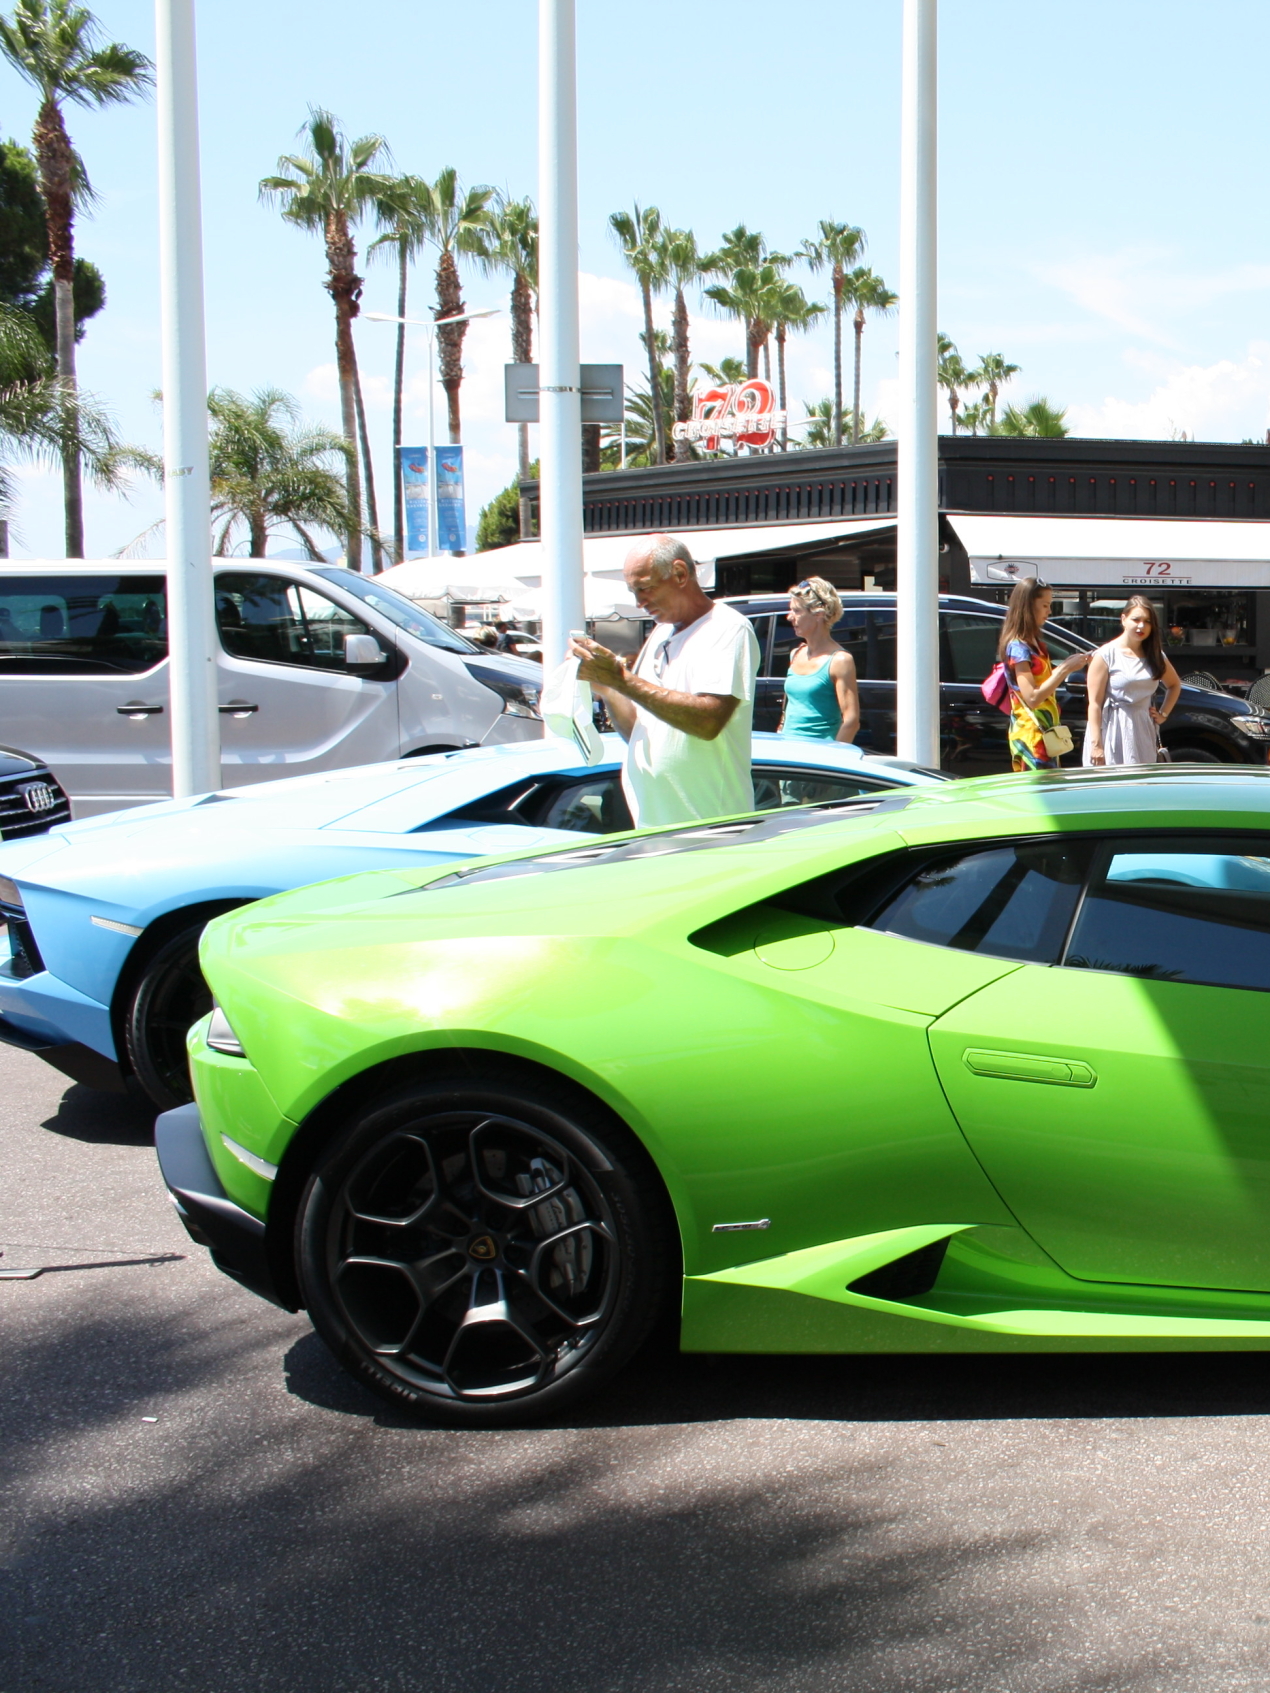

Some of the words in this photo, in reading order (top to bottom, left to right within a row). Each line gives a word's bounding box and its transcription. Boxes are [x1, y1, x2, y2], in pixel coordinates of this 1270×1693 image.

[671, 410, 788, 440] CROISETTE
[692, 379, 776, 452] 72
[1143, 562, 1172, 576] 72
